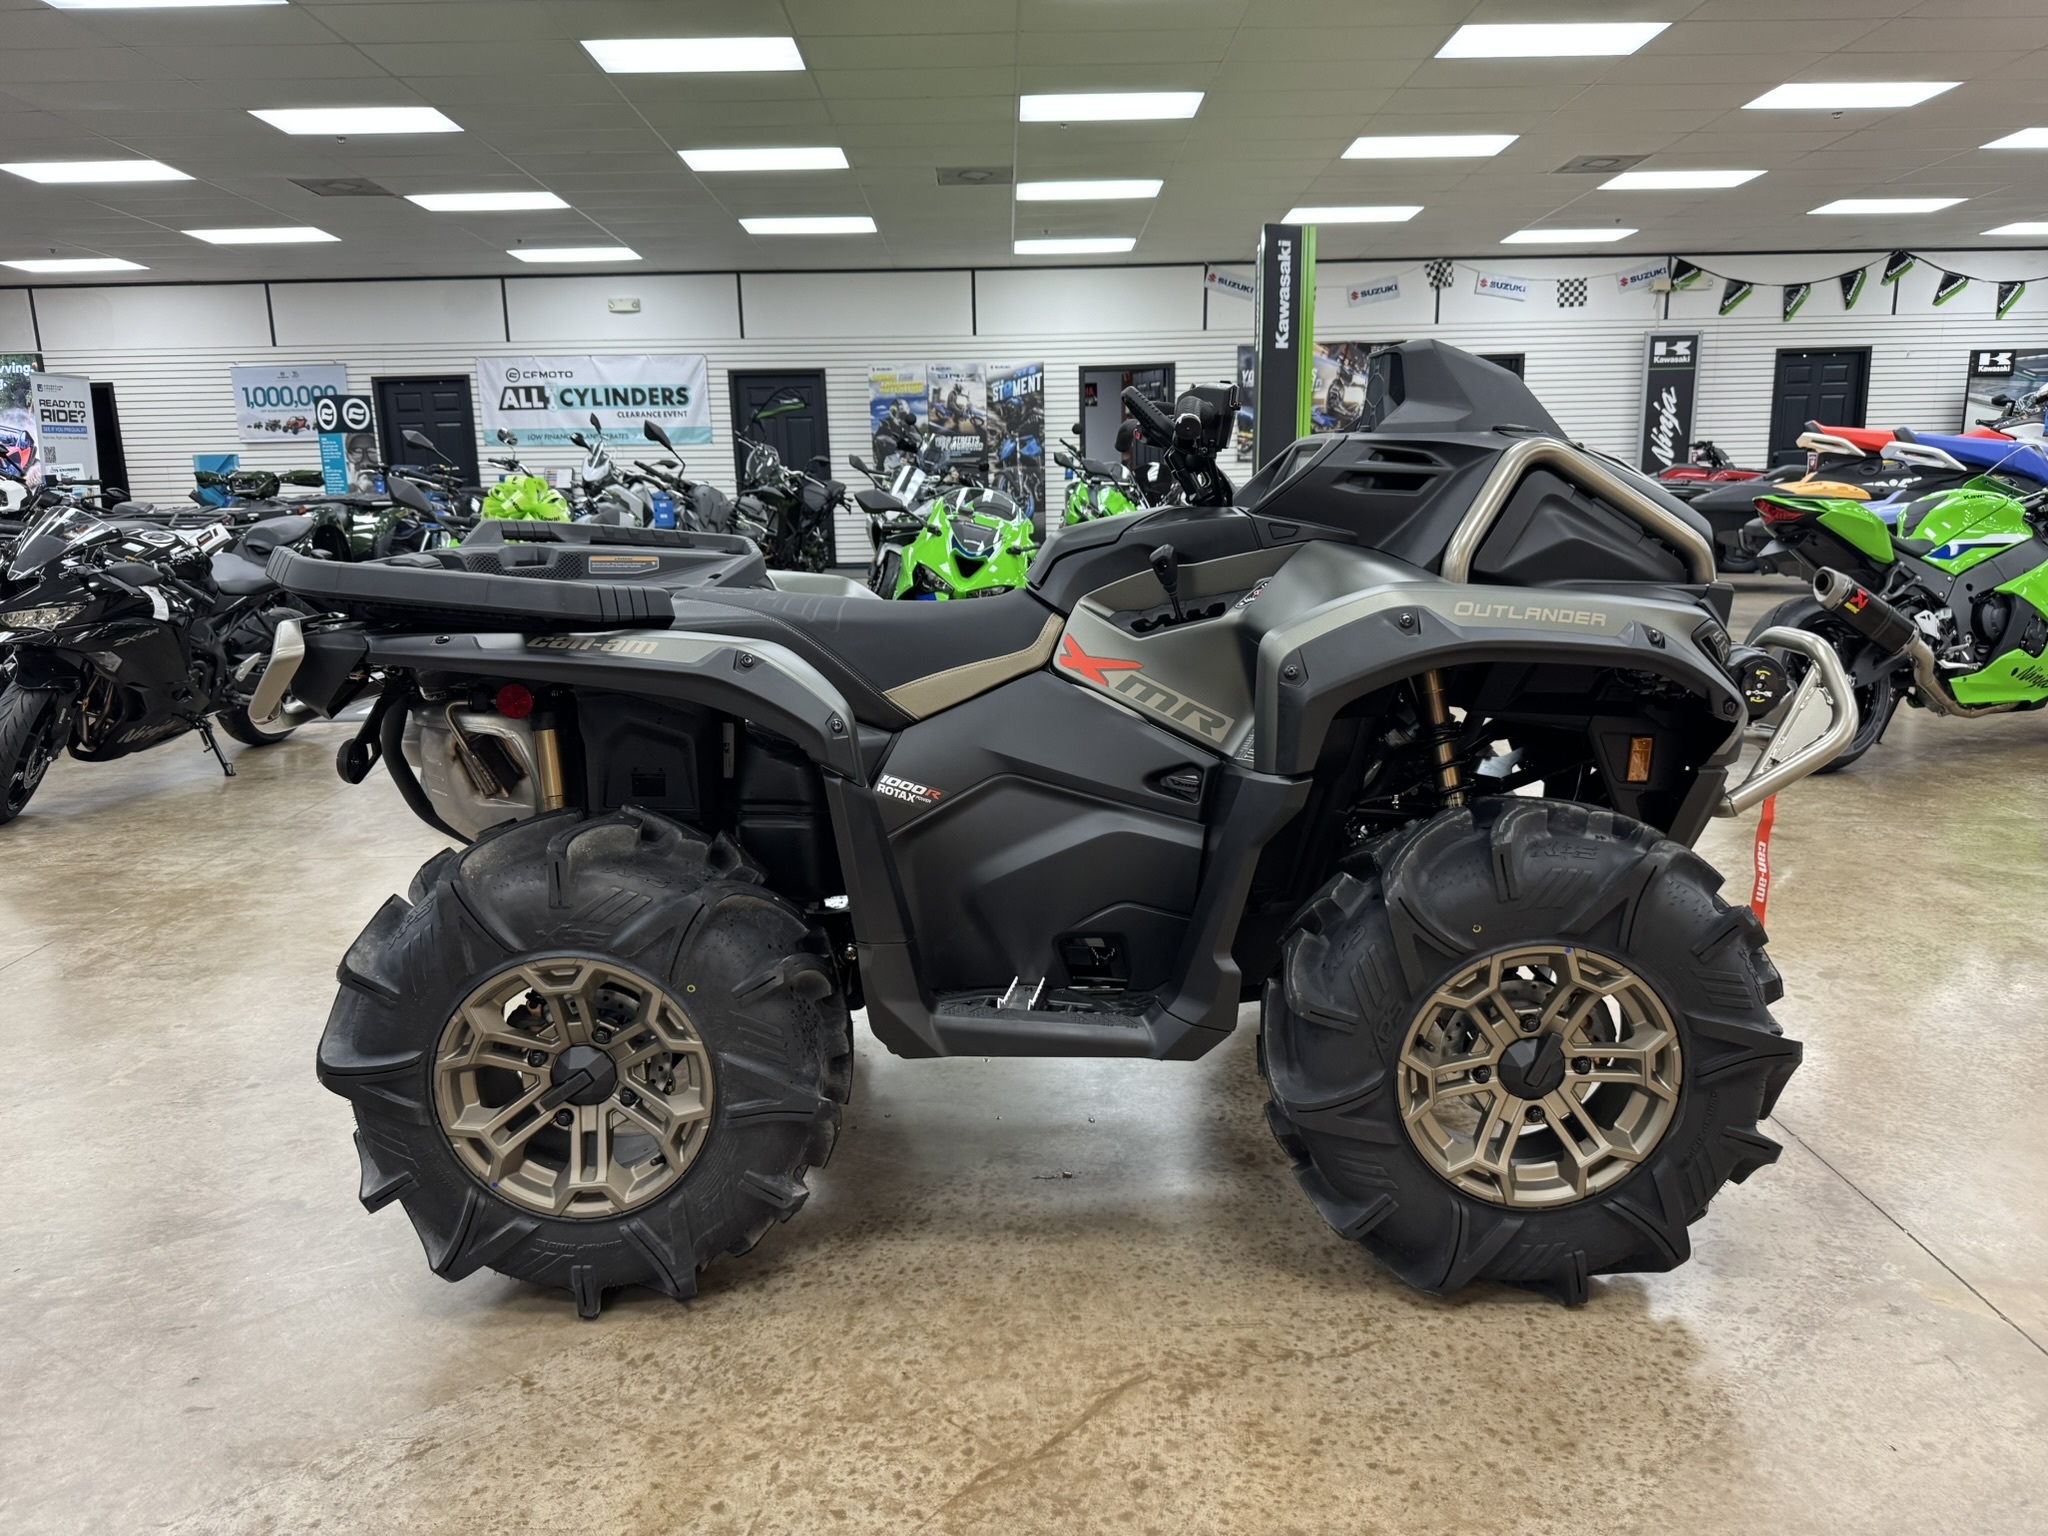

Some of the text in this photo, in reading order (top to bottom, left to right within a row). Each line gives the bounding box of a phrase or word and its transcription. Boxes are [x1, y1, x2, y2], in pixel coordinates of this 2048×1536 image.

[1630, 267, 1667, 283] SUZUKI
[1218, 277, 1254, 294] SUZUKI
[1361, 284, 1398, 298] SUZUKI
[1490, 280, 1526, 292] SUZUKI
[1275, 240, 1292, 349] Kawasaki
[1653, 355, 1690, 363] Kawasaki
[523, 371, 573, 379] CFMOTO
[1978, 365, 2010, 373] Kawasaki
[39, 399, 86, 409] READY TO
[502, 386, 689, 409] ALL CYLINDERS
[40, 408, 86, 423] RIDE?
[1650, 386, 1683, 467] Ninja
[527, 433, 542, 441] LOW
[1454, 601, 1607, 627] OUTLANDER
[527, 636, 659, 655] can-am
[877, 783, 932, 804] ROTAX POWER
[880, 775, 941, 800] 1000R
[1755, 840, 1768, 903] can-am
